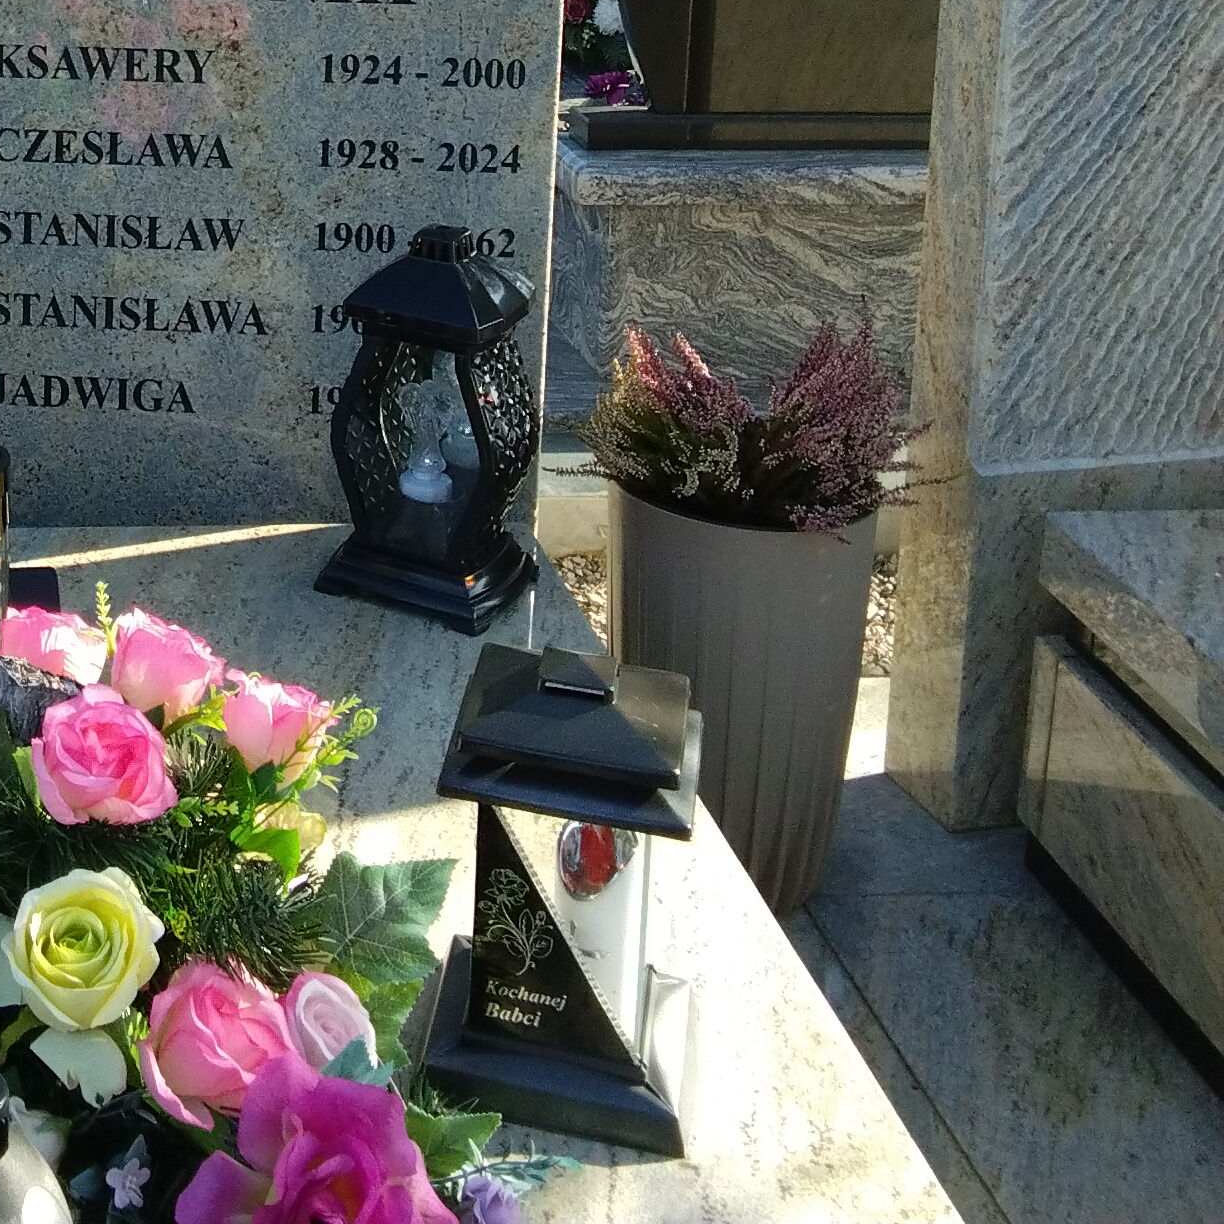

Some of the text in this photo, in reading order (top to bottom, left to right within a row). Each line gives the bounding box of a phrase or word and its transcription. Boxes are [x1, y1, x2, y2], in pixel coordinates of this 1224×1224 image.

[322, 53, 403, 87] 1924
[441, 57, 527, 91] 2000
[318, 138, 400, 172] 1928
[436, 141, 522, 175] 2024
[314, 222, 396, 254] 1900
[485, 979, 568, 1012] Kochanej
[485, 1001, 542, 1028] Babci
